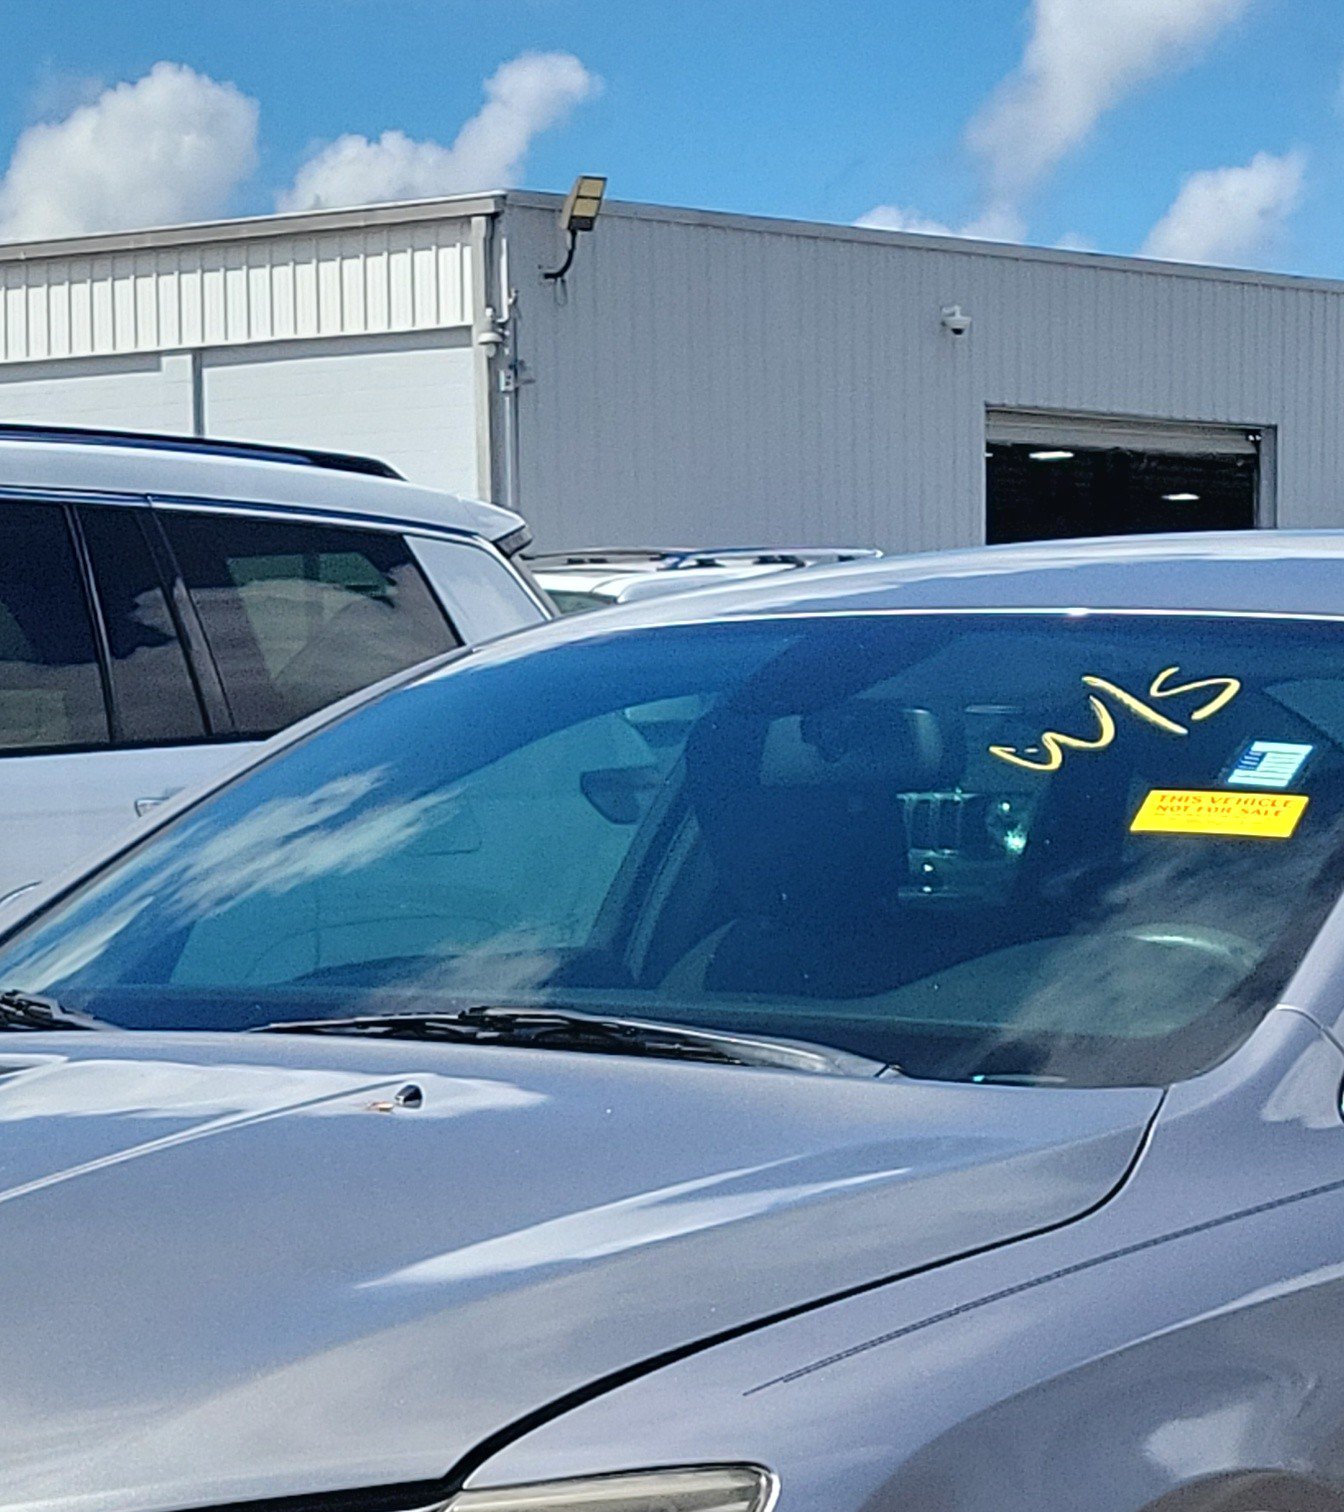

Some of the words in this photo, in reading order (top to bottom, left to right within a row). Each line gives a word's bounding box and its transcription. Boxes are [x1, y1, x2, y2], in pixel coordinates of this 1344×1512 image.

[1158, 793, 1203, 805] THIS
[1209, 795, 1293, 809] VEHICLE
[1155, 804, 1191, 814] NOT
[1195, 805, 1234, 815] FOR
[1240, 807, 1284, 818] SALE
